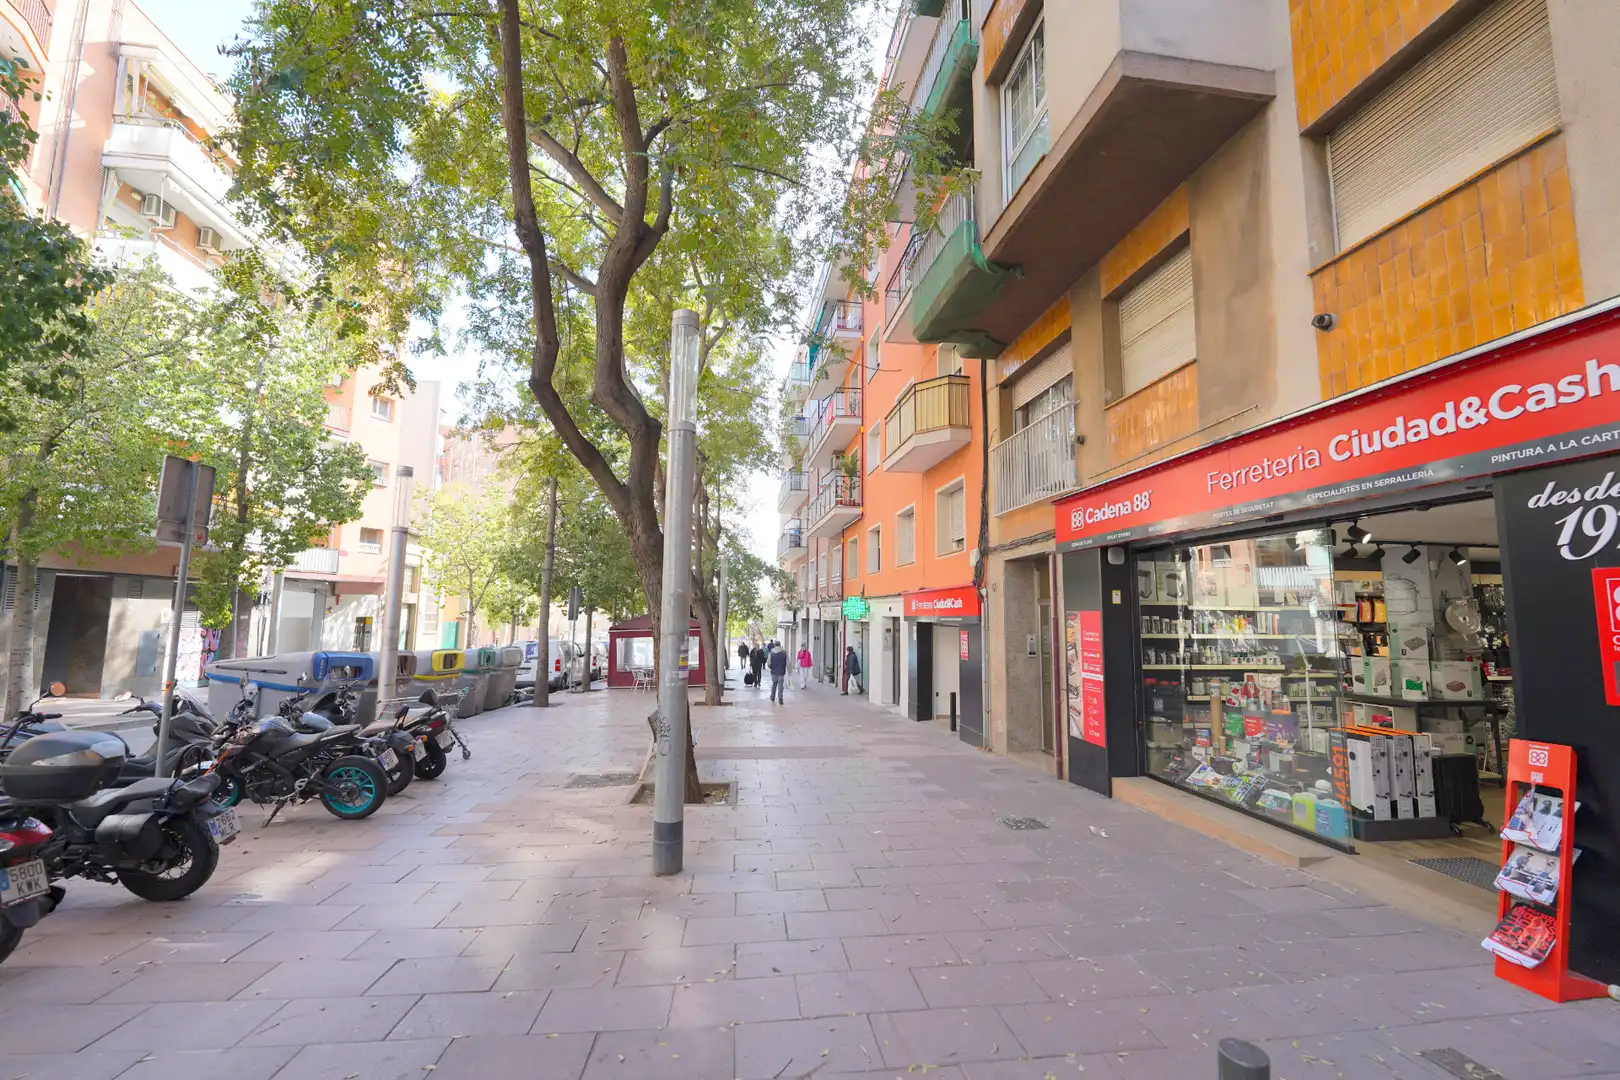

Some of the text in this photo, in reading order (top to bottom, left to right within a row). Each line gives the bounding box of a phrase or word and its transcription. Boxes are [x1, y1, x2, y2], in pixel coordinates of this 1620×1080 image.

[1207, 358, 1620, 494] Ferreteria Ciudad&Cash
[1491, 446, 1544, 464] PINTURA
[1546, 443, 1557, 453] A
[1559, 439, 1578, 450] LA
[1306, 469, 1434, 501] ESPECIALISTES EN SERRALLERIA
[1528, 471, 1620, 509] desde
[1085, 499, 1132, 524] Cadena
[1212, 509, 1233, 519] PORTES
[1240, 501, 1274, 515] SEGURETAT
[1554, 504, 1620, 561] 19
[215, 810, 236, 828] 2662
[219, 822, 236, 838] MLR
[10, 862, 43, 883] 5800
[17, 876, 42, 896] KWK
